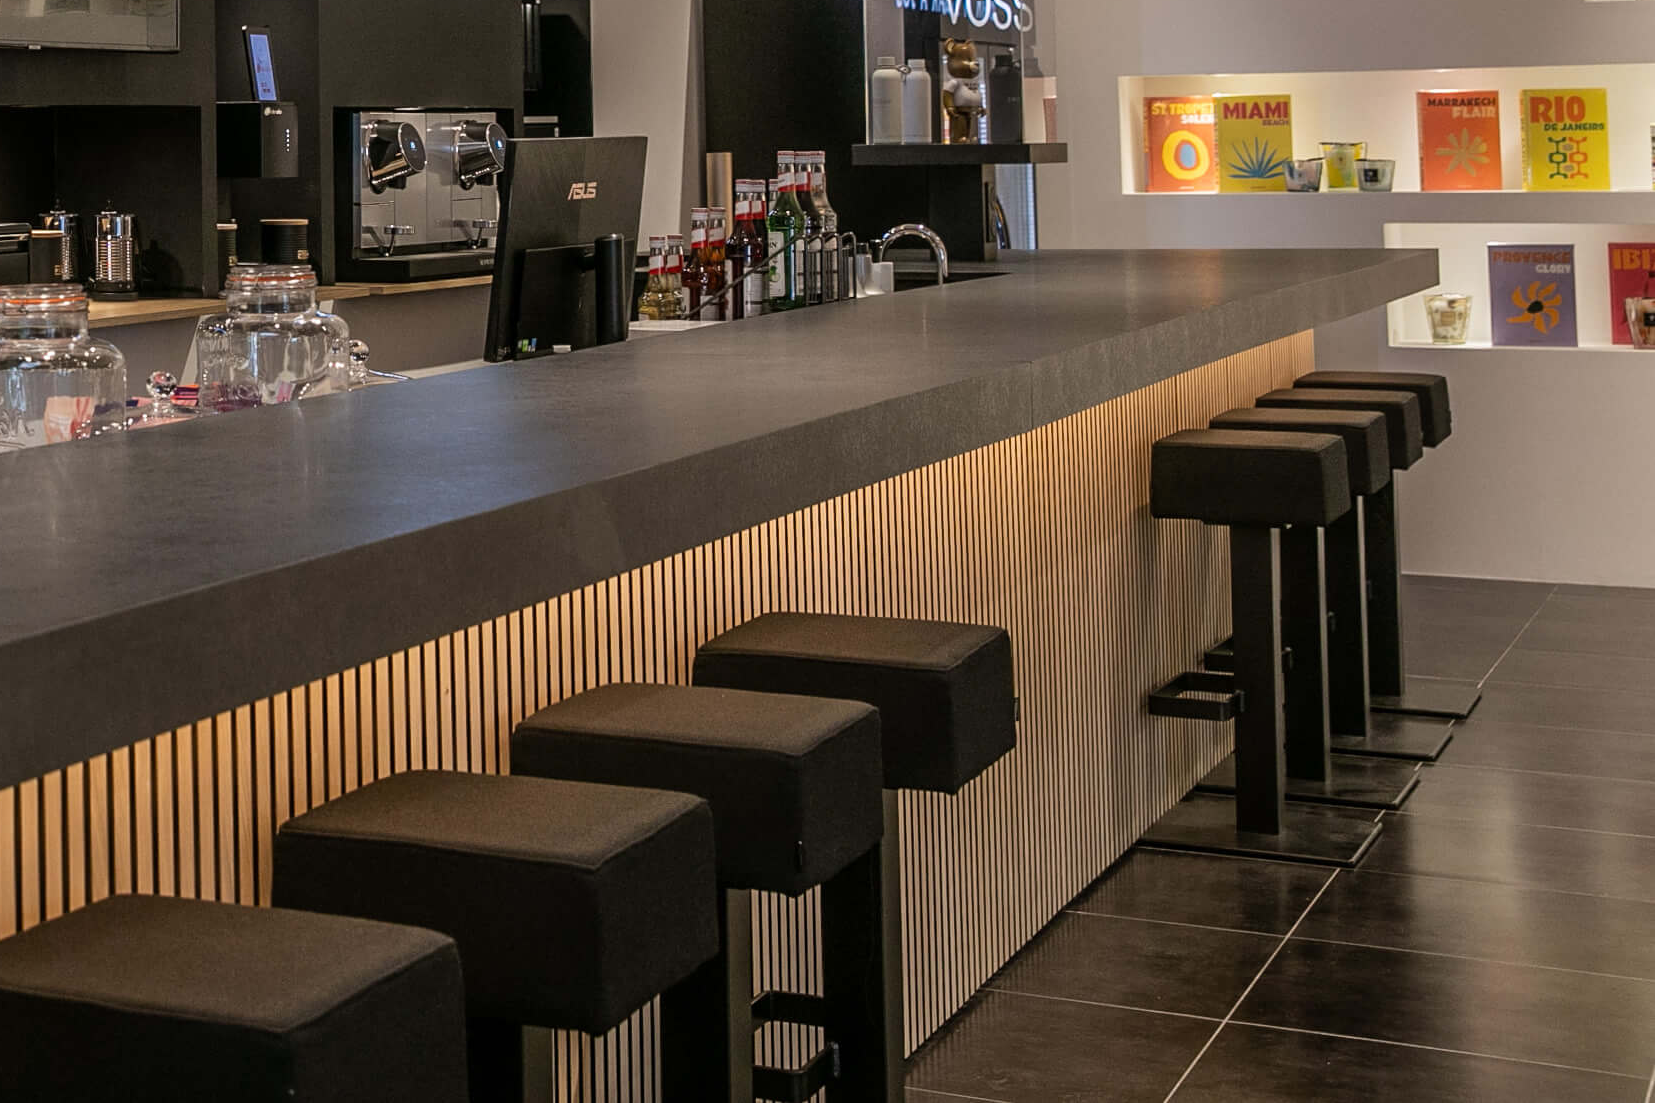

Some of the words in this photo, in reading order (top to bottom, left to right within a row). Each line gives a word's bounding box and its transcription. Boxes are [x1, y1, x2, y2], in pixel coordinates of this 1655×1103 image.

[1427, 96, 1496, 107] MARRAKECH
[1223, 100, 1289, 120] MIAMI
[1452, 106, 1496, 119] FLAIR
[1530, 95, 1586, 124] RIO
[1543, 122, 1558, 132] DE
[1560, 122, 1605, 132] JANEIRO
[568, 181, 597, 201] ASUS
[1491, 251, 1571, 264] PROVENCE
[1535, 264, 1571, 274] GLORY
